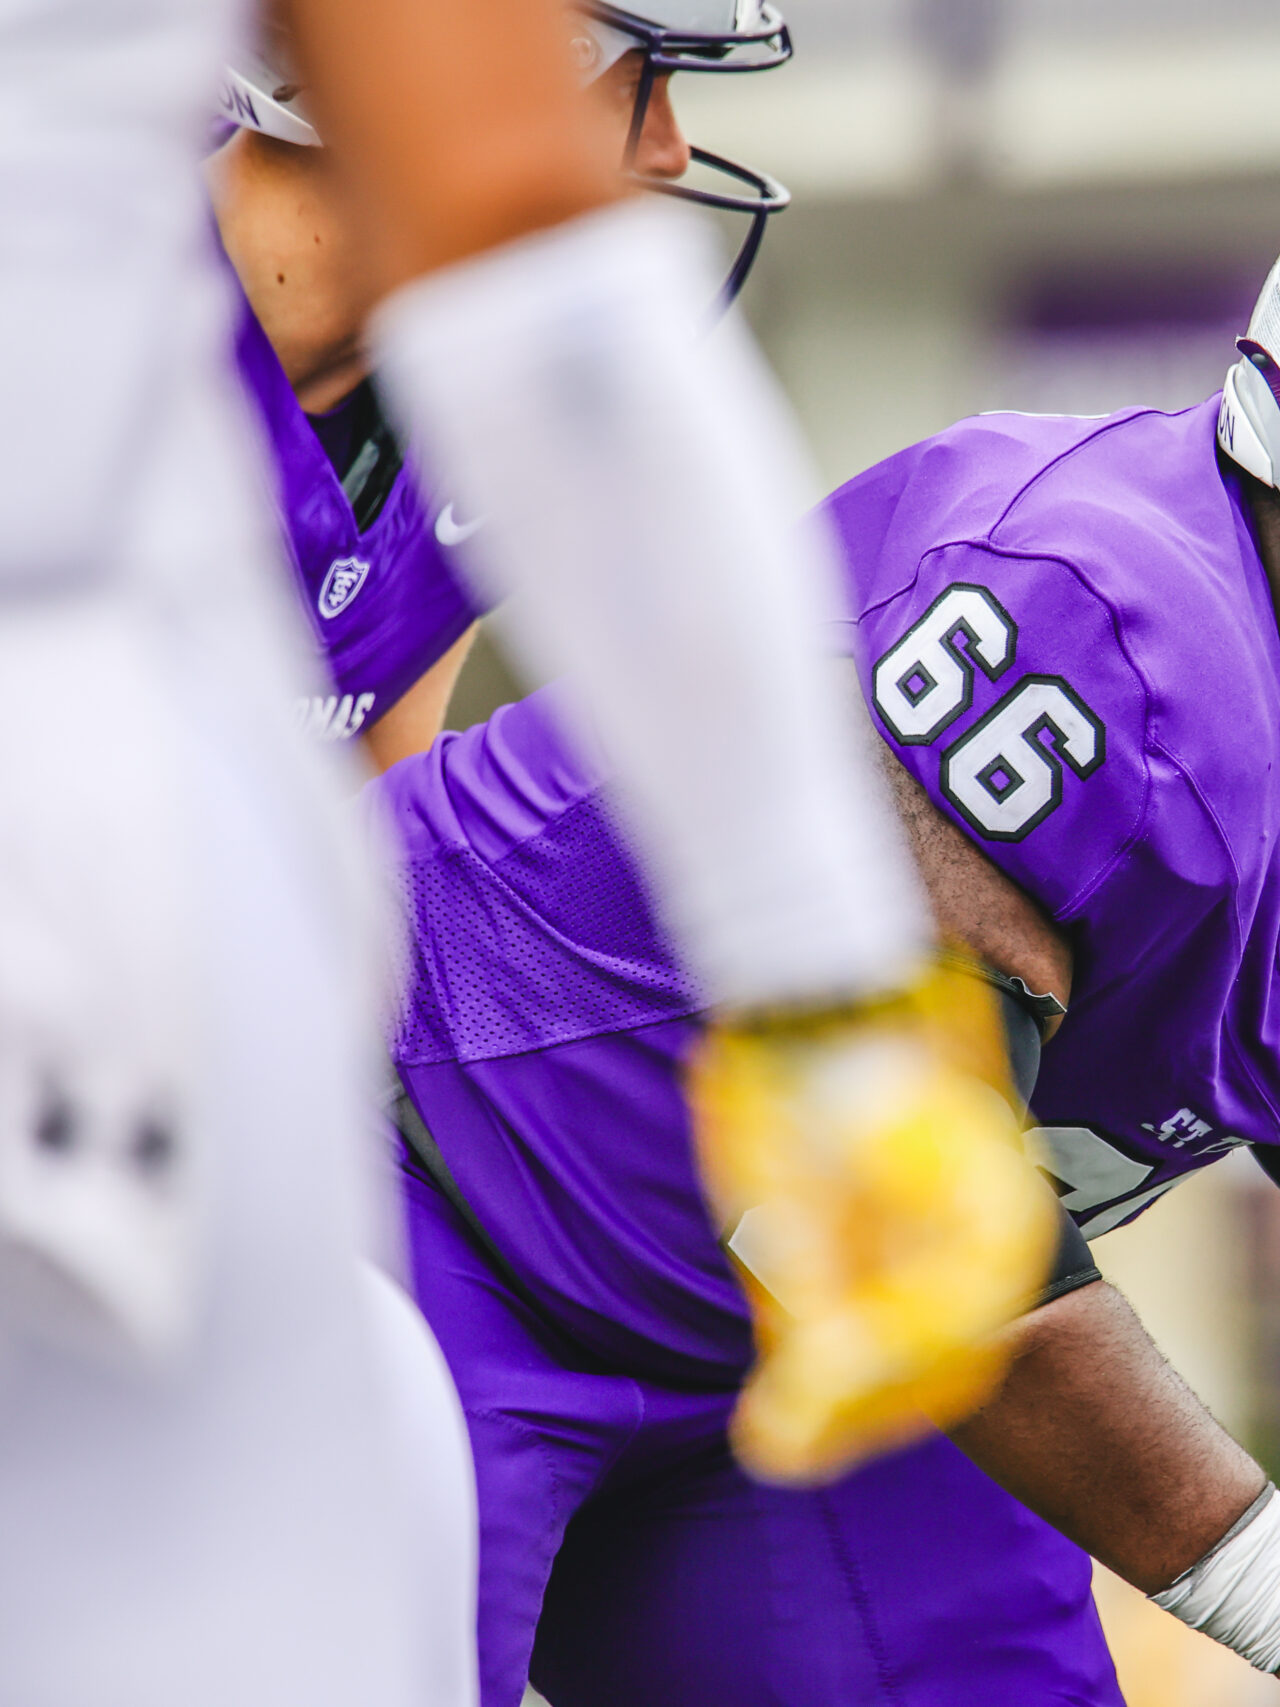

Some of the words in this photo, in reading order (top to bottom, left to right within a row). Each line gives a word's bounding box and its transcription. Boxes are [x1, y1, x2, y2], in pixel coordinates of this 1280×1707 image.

[220, 79, 260, 127] ON
[1220, 396, 1235, 452] ON
[872, 582, 1107, 843] 66
